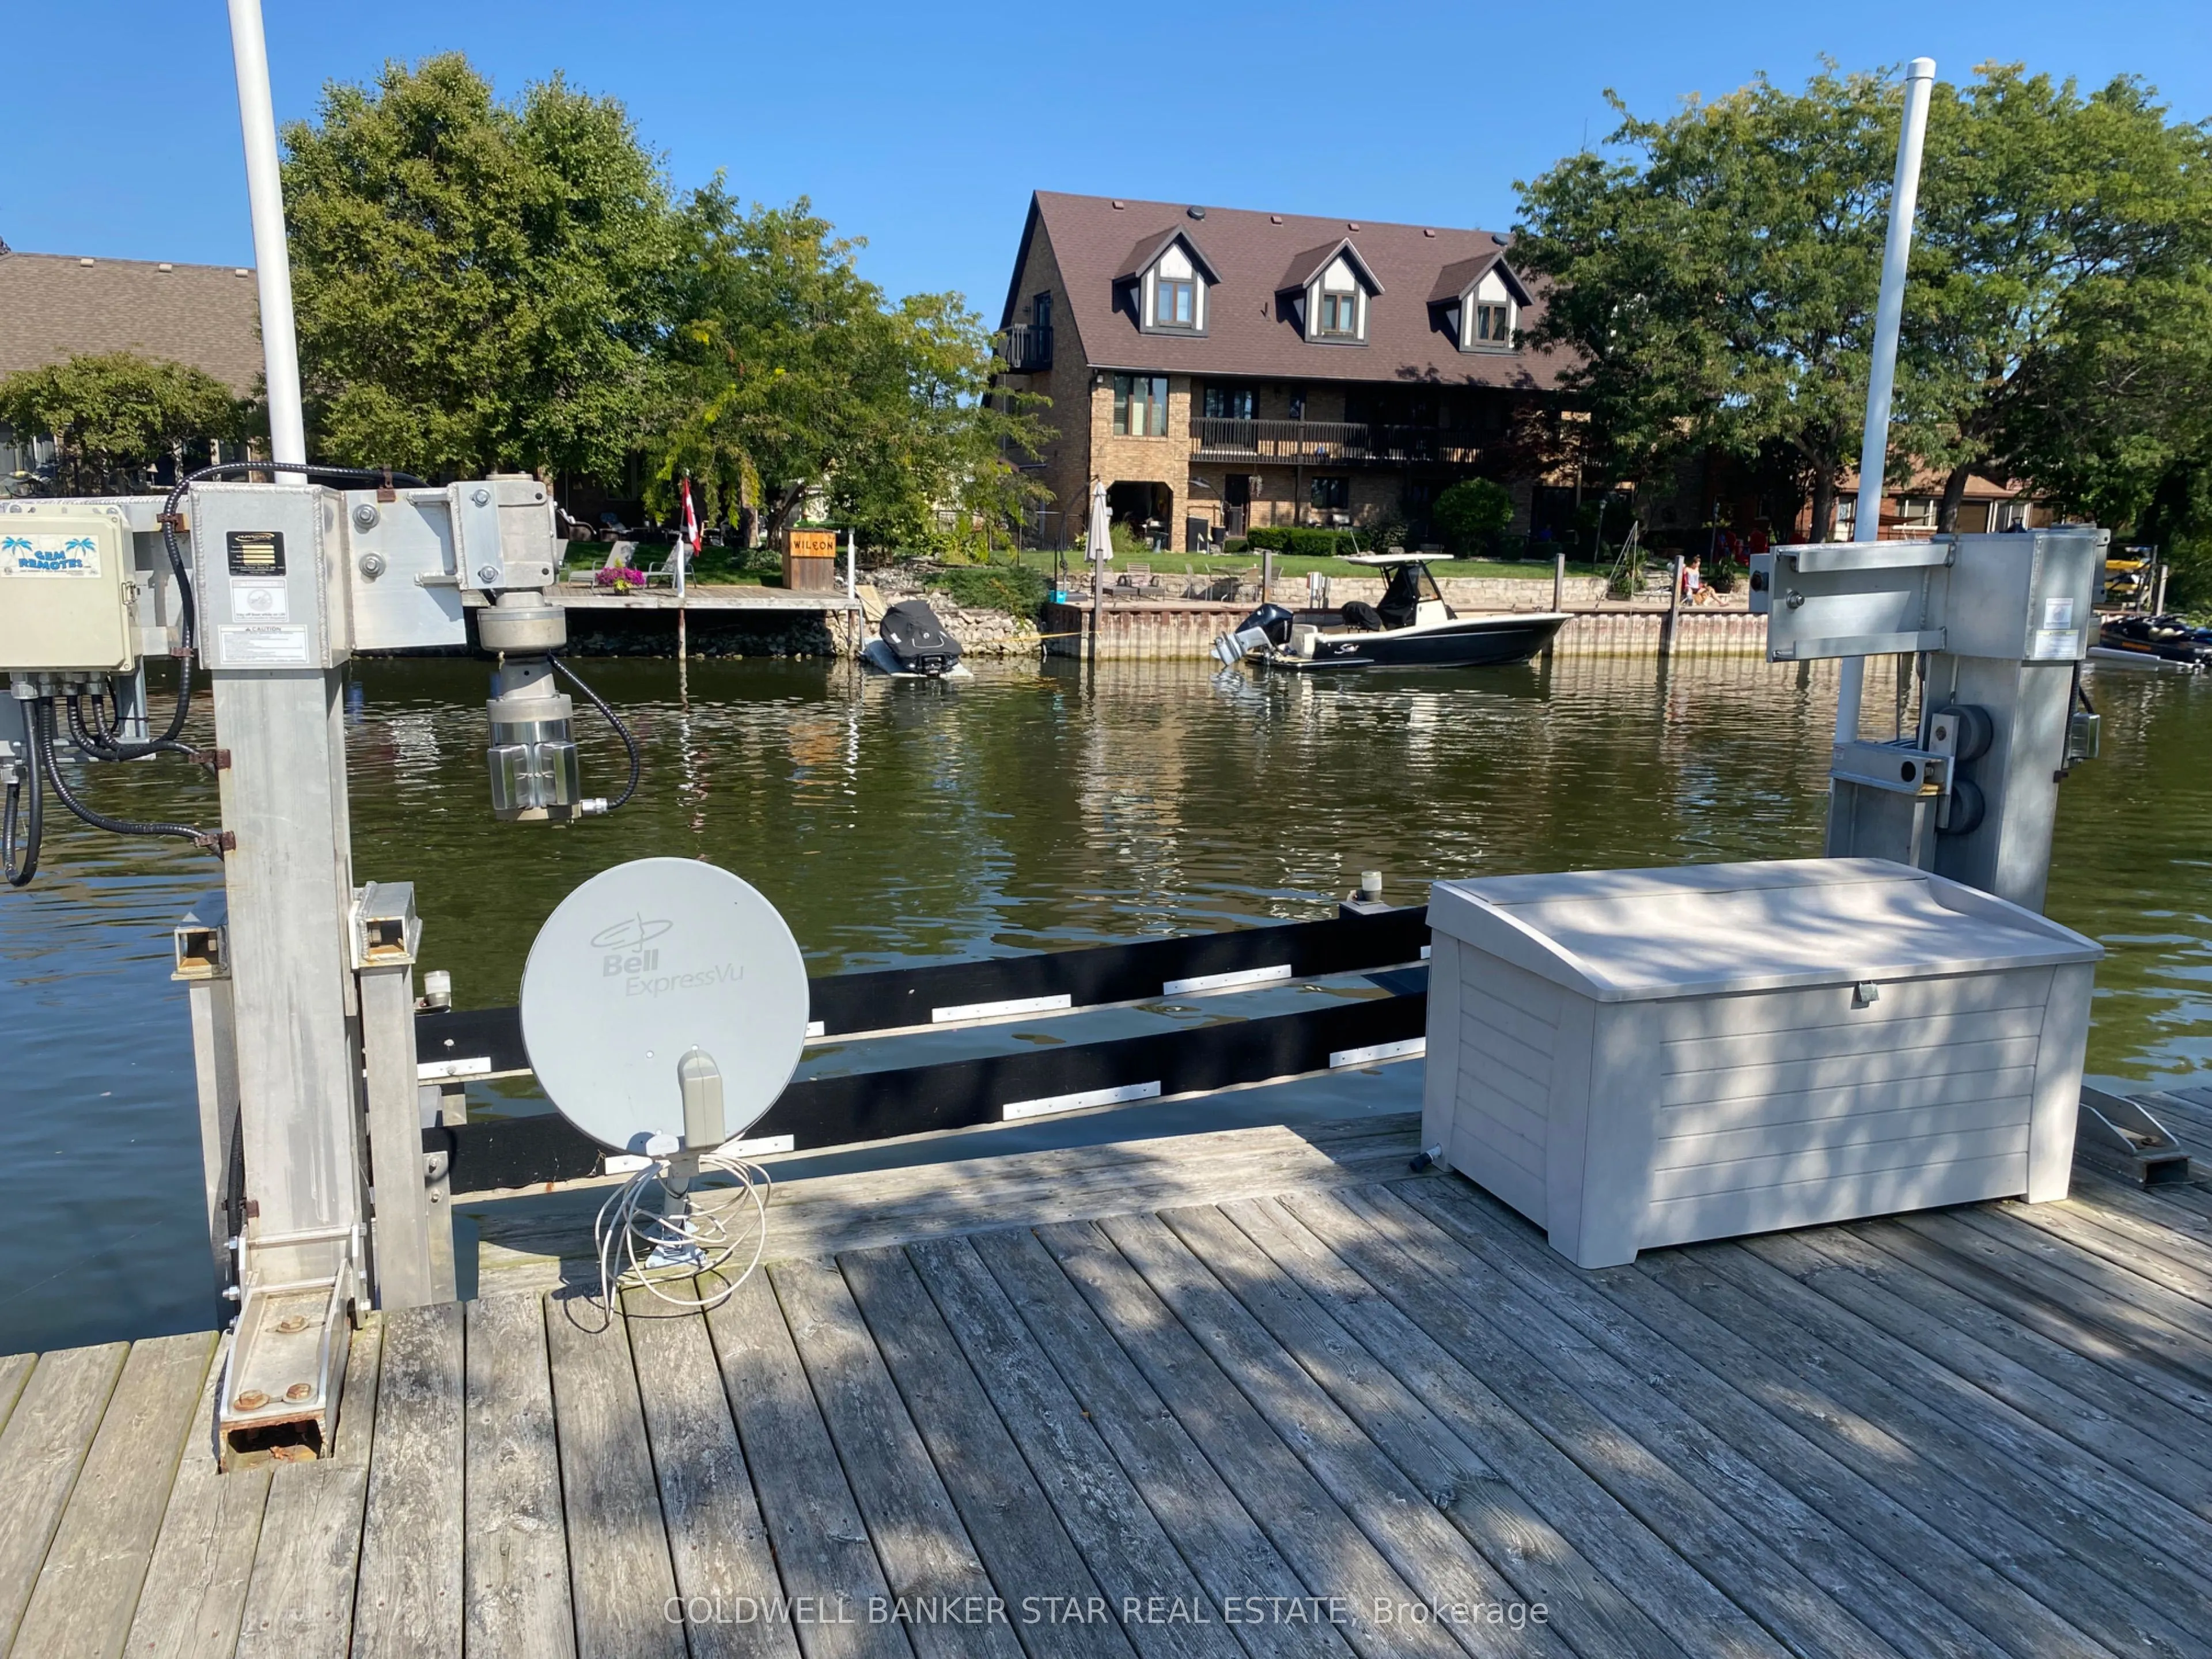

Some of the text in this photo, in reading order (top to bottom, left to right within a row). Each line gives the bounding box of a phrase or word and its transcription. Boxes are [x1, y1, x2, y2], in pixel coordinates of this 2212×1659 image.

[18, 558, 83, 570] REMOTES
[35, 551, 66, 560] GEM
[603, 948, 659, 977] Bell
[625, 963, 744, 998] ExpressVu
